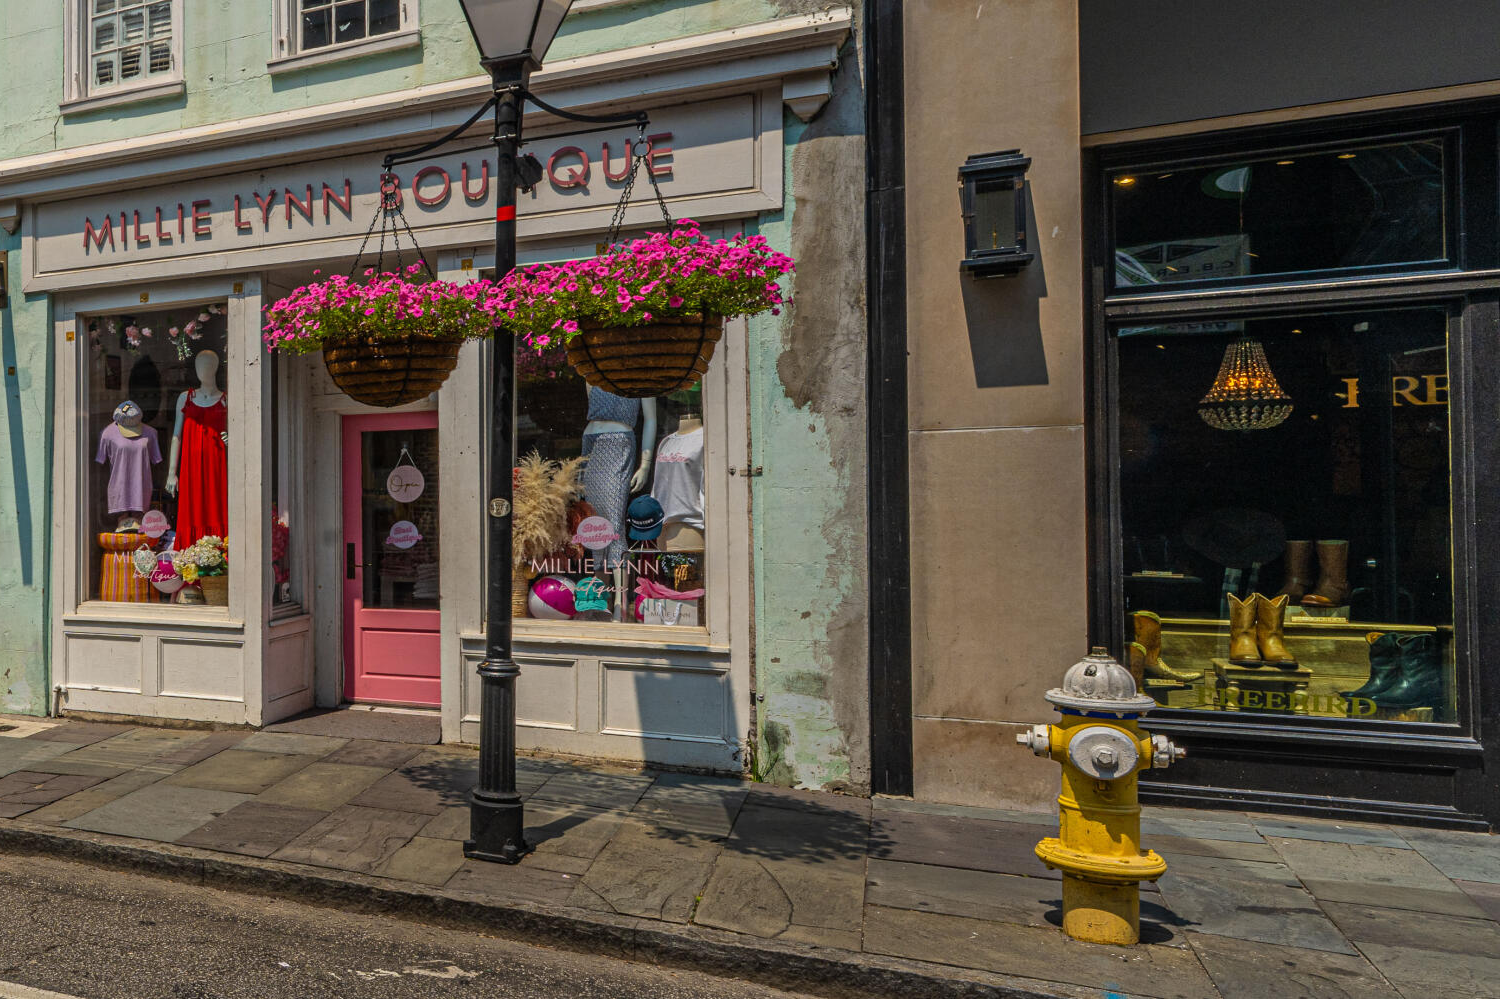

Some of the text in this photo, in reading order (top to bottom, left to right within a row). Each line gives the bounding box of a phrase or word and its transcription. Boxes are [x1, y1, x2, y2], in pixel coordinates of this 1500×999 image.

[82, 132, 673, 249] MILLIE LYNN BOUQUE
[390, 474, 420, 493] Open
[582, 522, 608, 533] Best
[571, 532, 621, 545] Boutique
[530, 558, 660, 575] MILLIE LYNN
[558, 575, 629, 598] boutique
[1198, 686, 1378, 717] FREEBIRD
